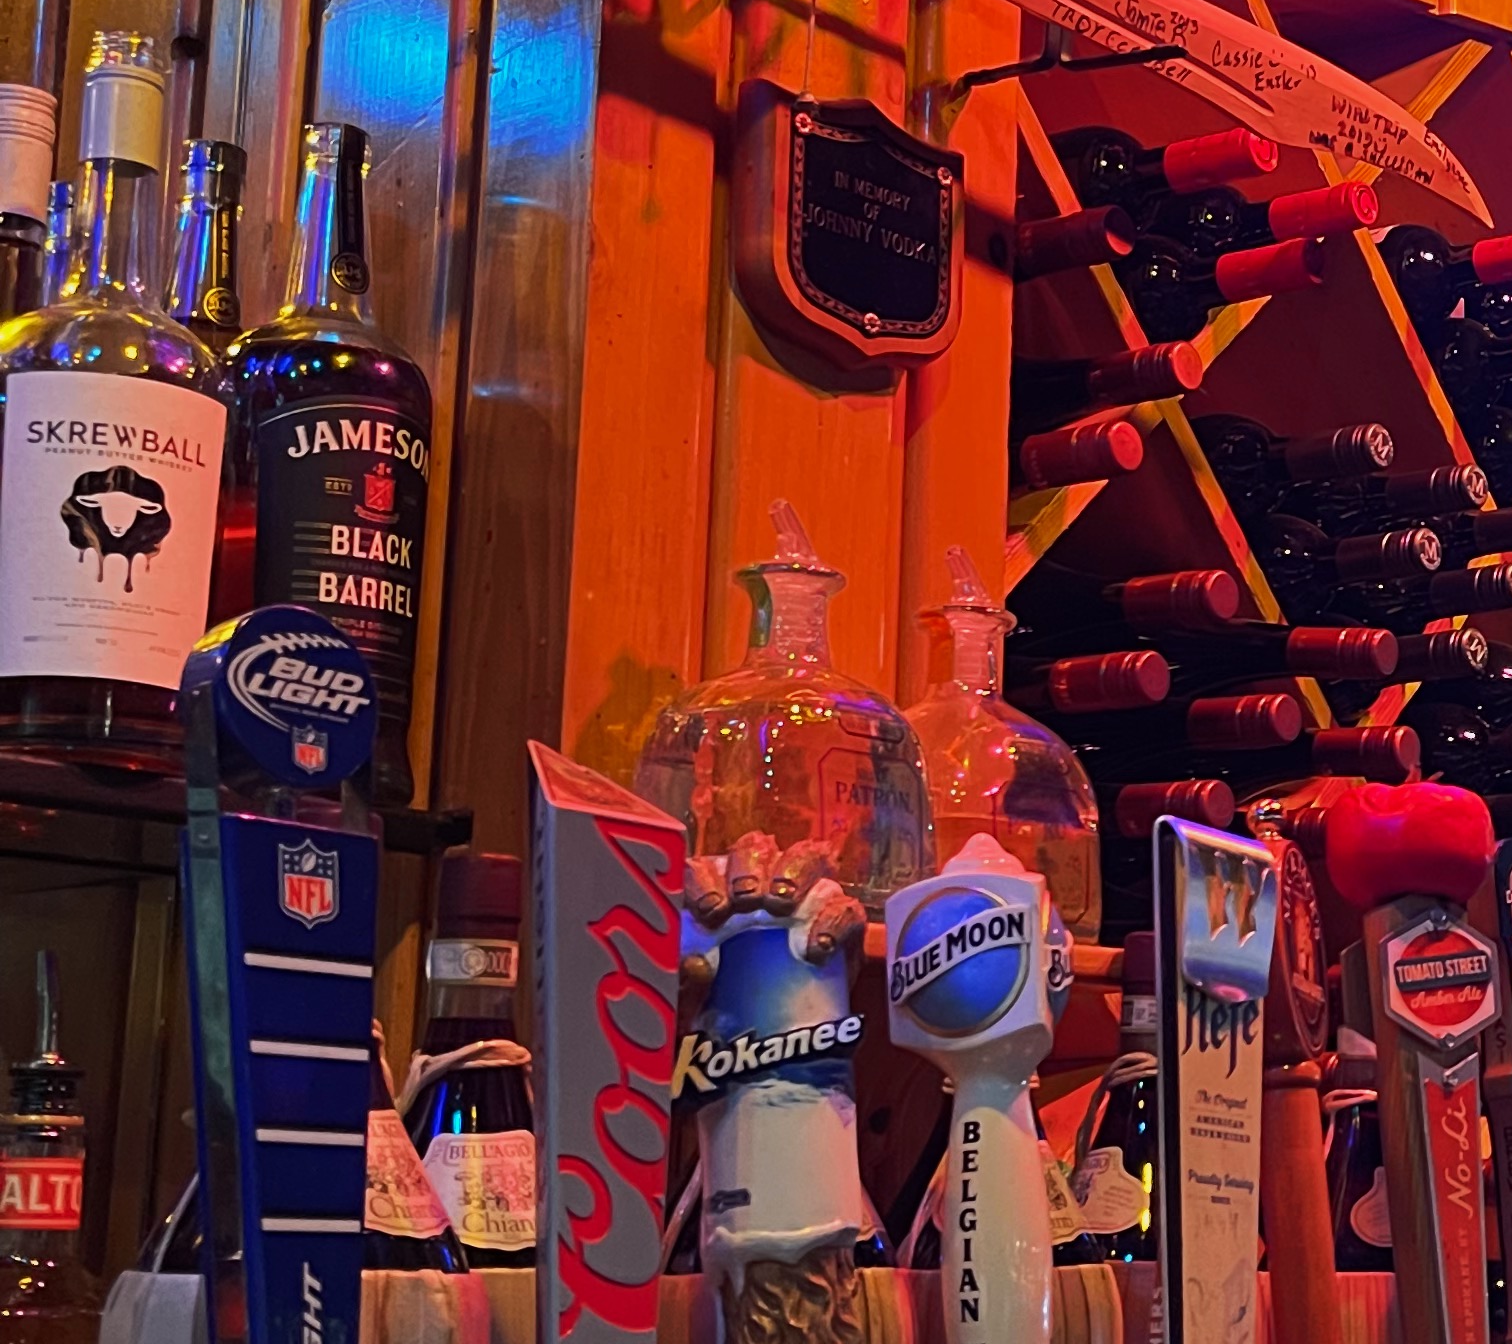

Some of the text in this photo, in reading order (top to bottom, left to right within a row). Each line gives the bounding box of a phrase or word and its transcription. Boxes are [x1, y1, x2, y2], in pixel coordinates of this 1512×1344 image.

[1211, 40, 1264, 69] Cassie
[853, 180, 912, 212] MEMORY
[862, 202, 881, 222] OF
[804, 202, 938, 265] JOHNNY VODKA
[26, 420, 206, 468] SKREWBALL
[331, 524, 414, 570] BLACK
[318, 571, 414, 619] BARREL
[249, 673, 371, 716] LIGHT
[268, 656, 366, 694] BUD
[284, 873, 333, 917] NFL
[890, 911, 1025, 1003] BLUE MOON
[1396, 955, 1487, 984] TOMATO STREET
[557, 816, 688, 1339] Coors
[670, 1015, 862, 1099] Kokanee
[1440, 1096, 1474, 1220] No-Li
[462, 1212, 536, 1234] Chian
[958, 1120, 982, 1323] BELGIAN
